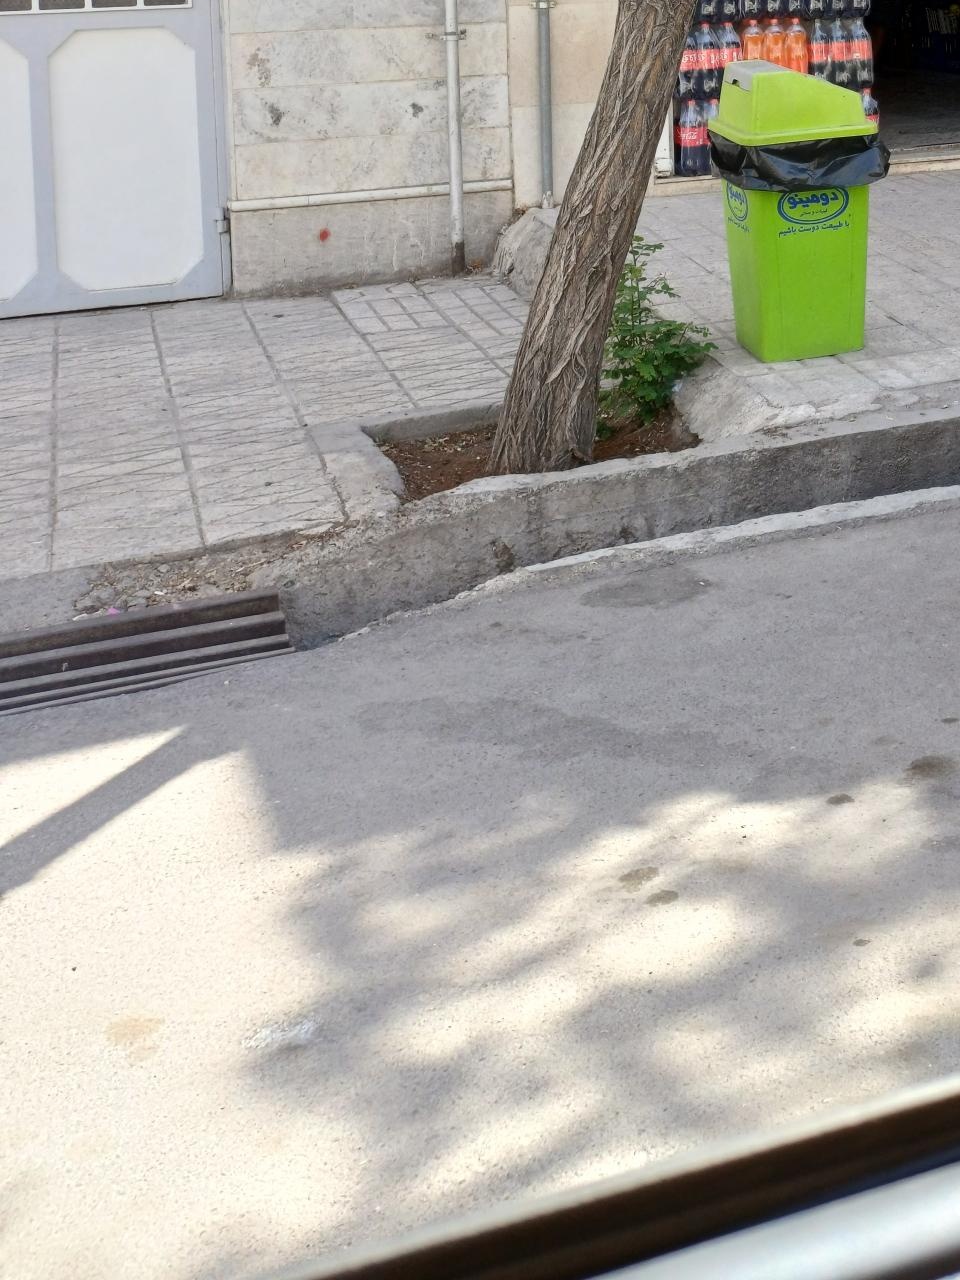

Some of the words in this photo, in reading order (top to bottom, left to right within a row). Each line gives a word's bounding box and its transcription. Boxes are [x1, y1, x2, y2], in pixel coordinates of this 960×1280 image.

[786, 191, 840, 209] دومینو
[778, 226, 797, 238] باشیم
[798, 224, 820, 232] دوست
